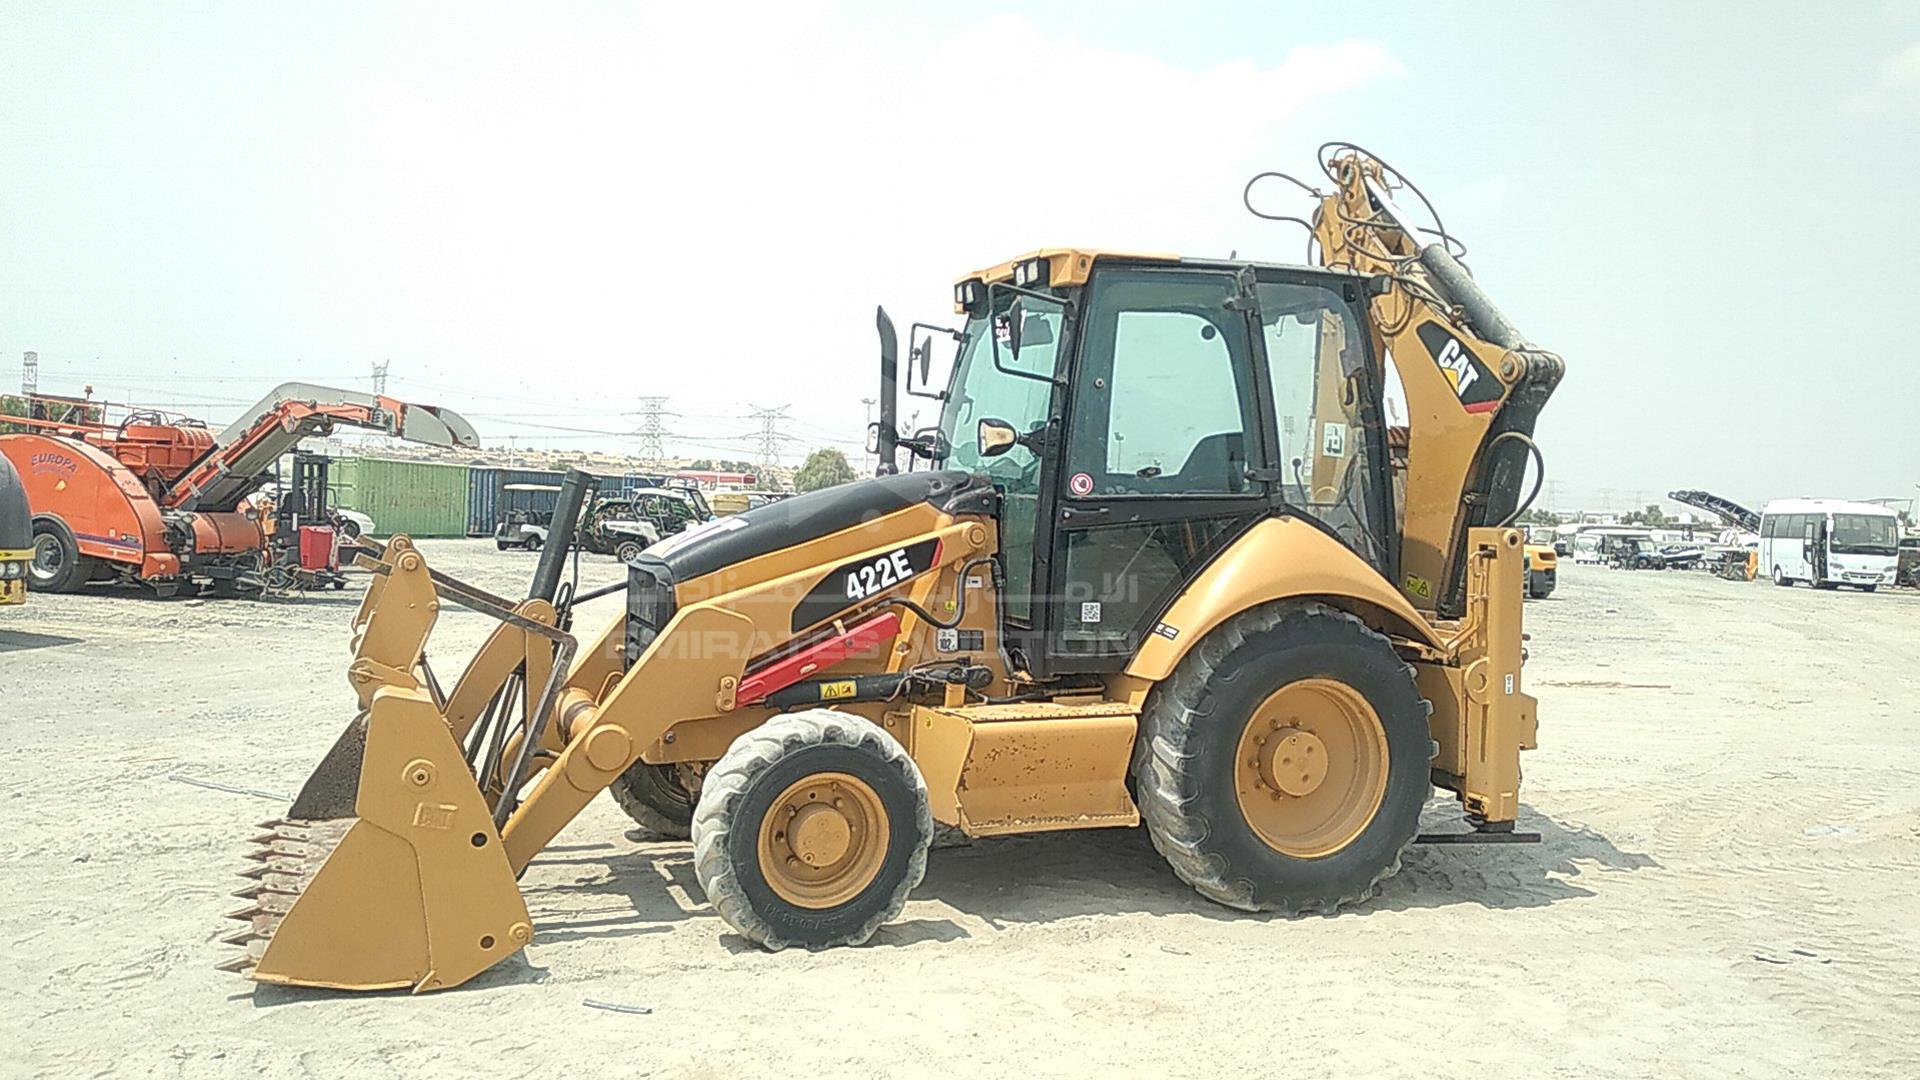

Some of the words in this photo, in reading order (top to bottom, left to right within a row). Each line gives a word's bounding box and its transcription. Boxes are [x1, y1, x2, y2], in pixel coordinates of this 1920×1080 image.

[1438, 338, 1479, 396] CAT
[31, 452, 78, 473] EUROPA
[846, 548, 913, 599] 422E
